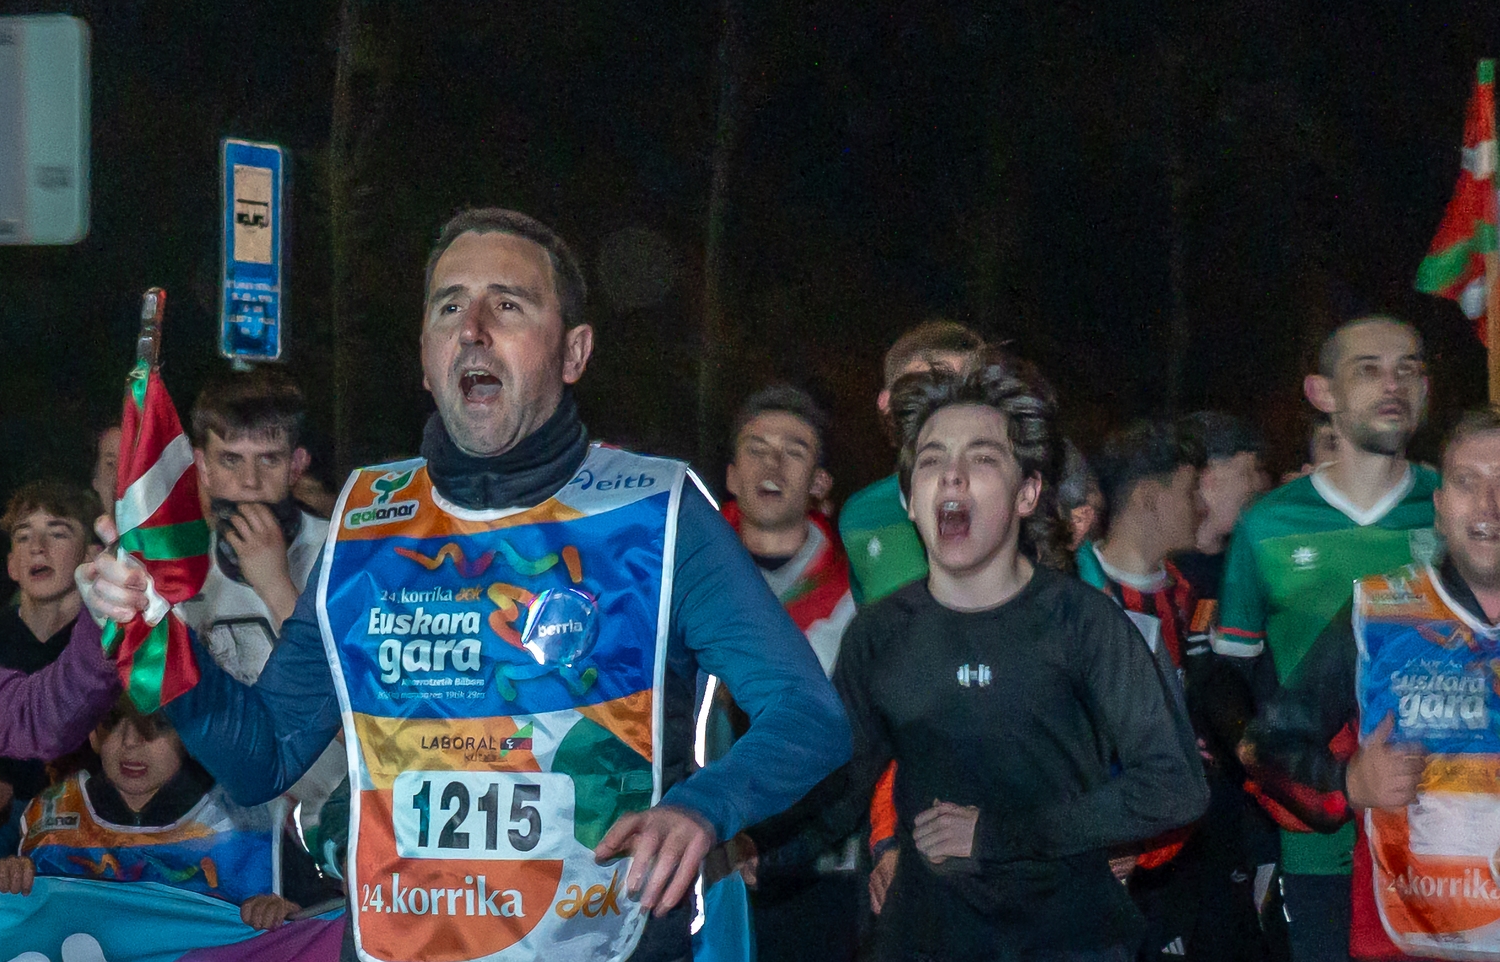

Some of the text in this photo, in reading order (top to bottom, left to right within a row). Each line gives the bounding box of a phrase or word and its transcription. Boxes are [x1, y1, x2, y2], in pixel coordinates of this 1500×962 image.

[596, 473, 656, 491] eitb
[368, 606, 480, 635] Euskara
[378, 638, 482, 684] gara
[421, 735, 497, 751] LABORAL
[412, 780, 542, 852] 1215
[361, 872, 526, 918] 24.korrika
